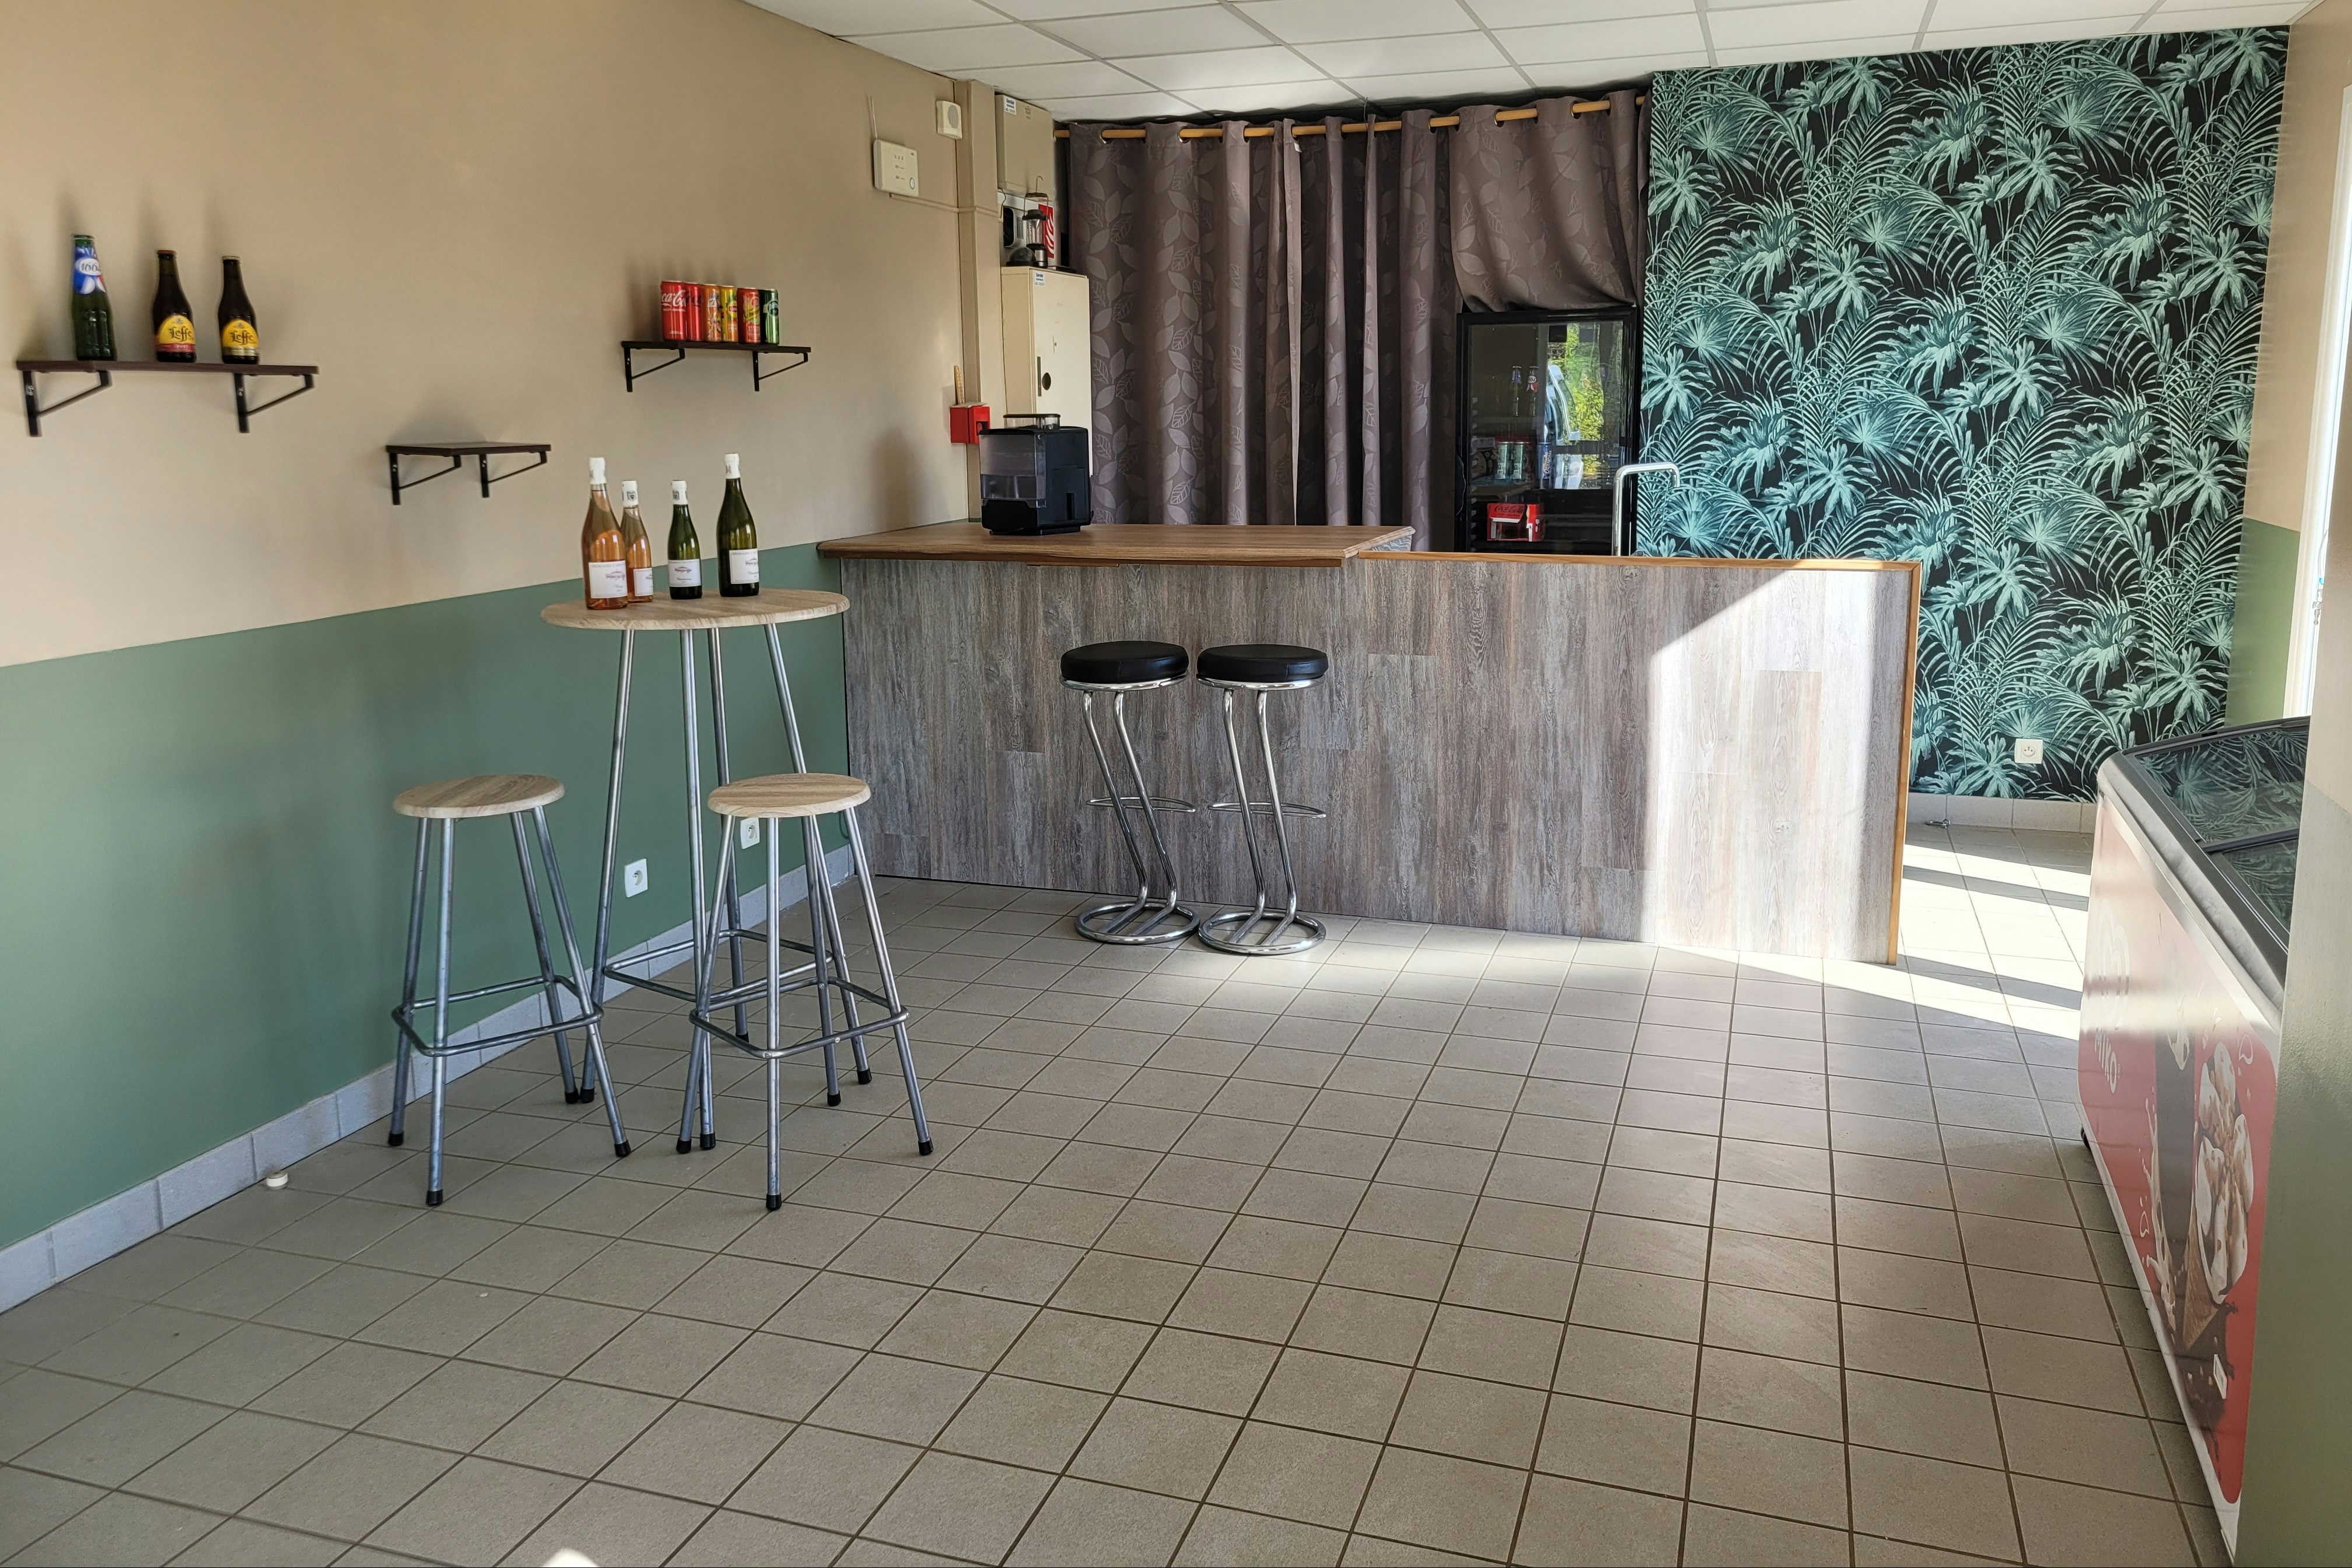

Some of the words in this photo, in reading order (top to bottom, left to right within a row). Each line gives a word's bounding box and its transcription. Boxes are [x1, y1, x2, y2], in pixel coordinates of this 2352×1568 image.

[169, 326, 192, 342] Leffe
[229, 330, 255, 346] Leffe
[2094, 1027, 2117, 1093] MIKO
